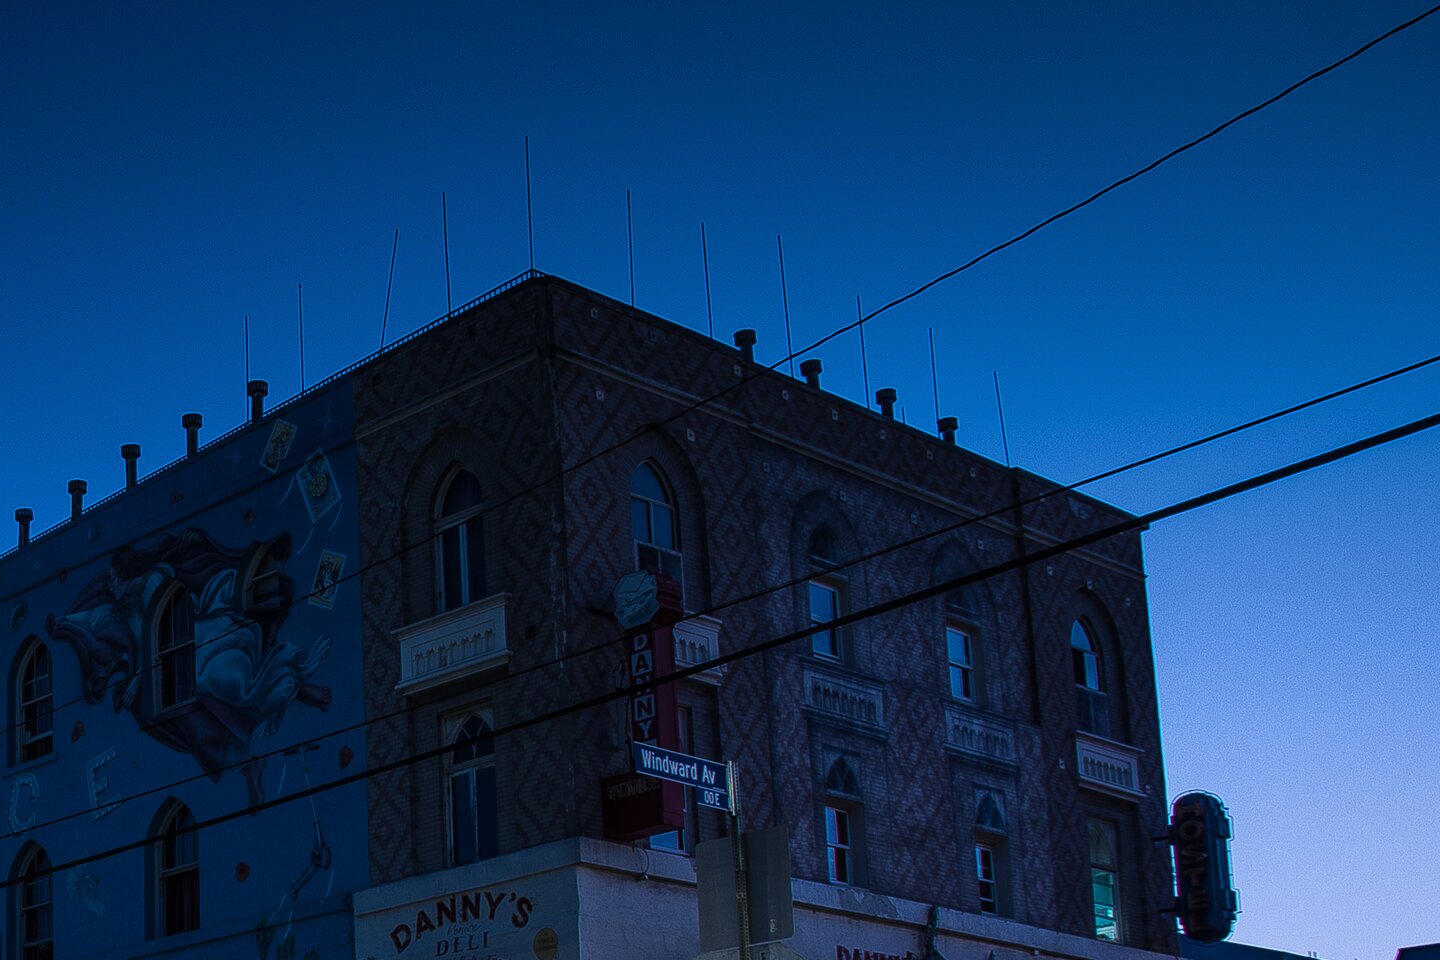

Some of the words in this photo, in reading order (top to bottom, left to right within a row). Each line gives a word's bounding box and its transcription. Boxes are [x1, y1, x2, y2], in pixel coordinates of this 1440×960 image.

[632, 632, 657, 744] DANNY
[640, 748, 698, 781] Windward
[702, 764, 717, 785] Av
[390, 891, 533, 954] DANNY'S
[436, 930, 490, 956] DELI
